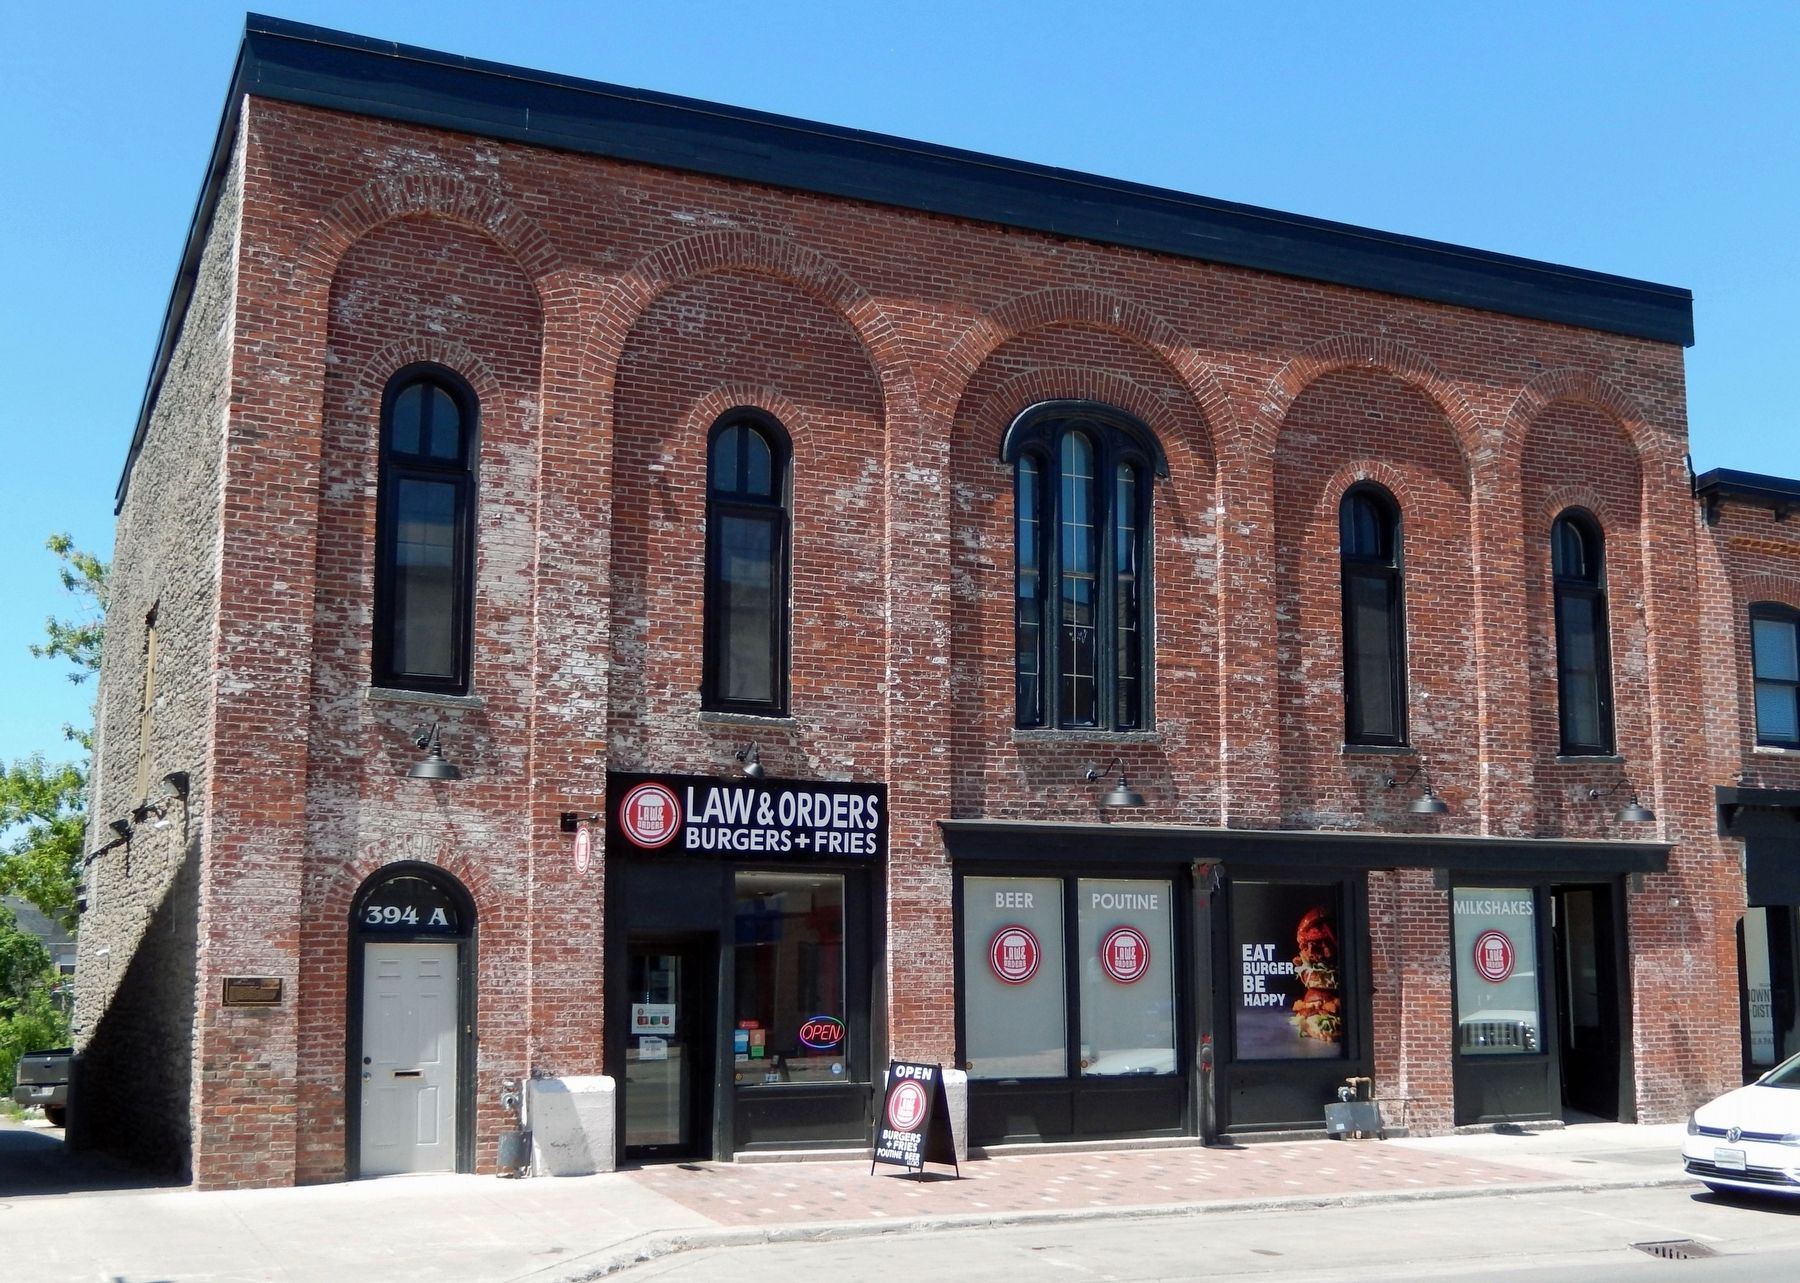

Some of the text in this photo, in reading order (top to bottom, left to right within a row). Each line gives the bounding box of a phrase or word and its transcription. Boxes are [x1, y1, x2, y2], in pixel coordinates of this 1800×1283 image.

[687, 786, 879, 829] LAW & ORDERS
[685, 827, 792, 852] BURGERS
[815, 831, 877, 854] FRIES
[995, 892, 1034, 908] BEER
[1092, 893, 1158, 910] POUTINE
[1453, 900, 1533, 915] MILKSHAKES
[366, 905, 449, 926] 394 A
[1242, 944, 1275, 961] EAT
[1243, 962, 1294, 975] BURGER
[1243, 975, 1266, 993] BE
[1244, 993, 1286, 1007] HAPPY
[1748, 989, 1770, 1003] OWN
[801, 1023, 841, 1040] OPEN
[896, 1065, 933, 1080] OPEN
[882, 1129, 922, 1143] BURGERS
[877, 1148, 903, 1159] POUTINE
[893, 1140, 918, 1152] FRIES
